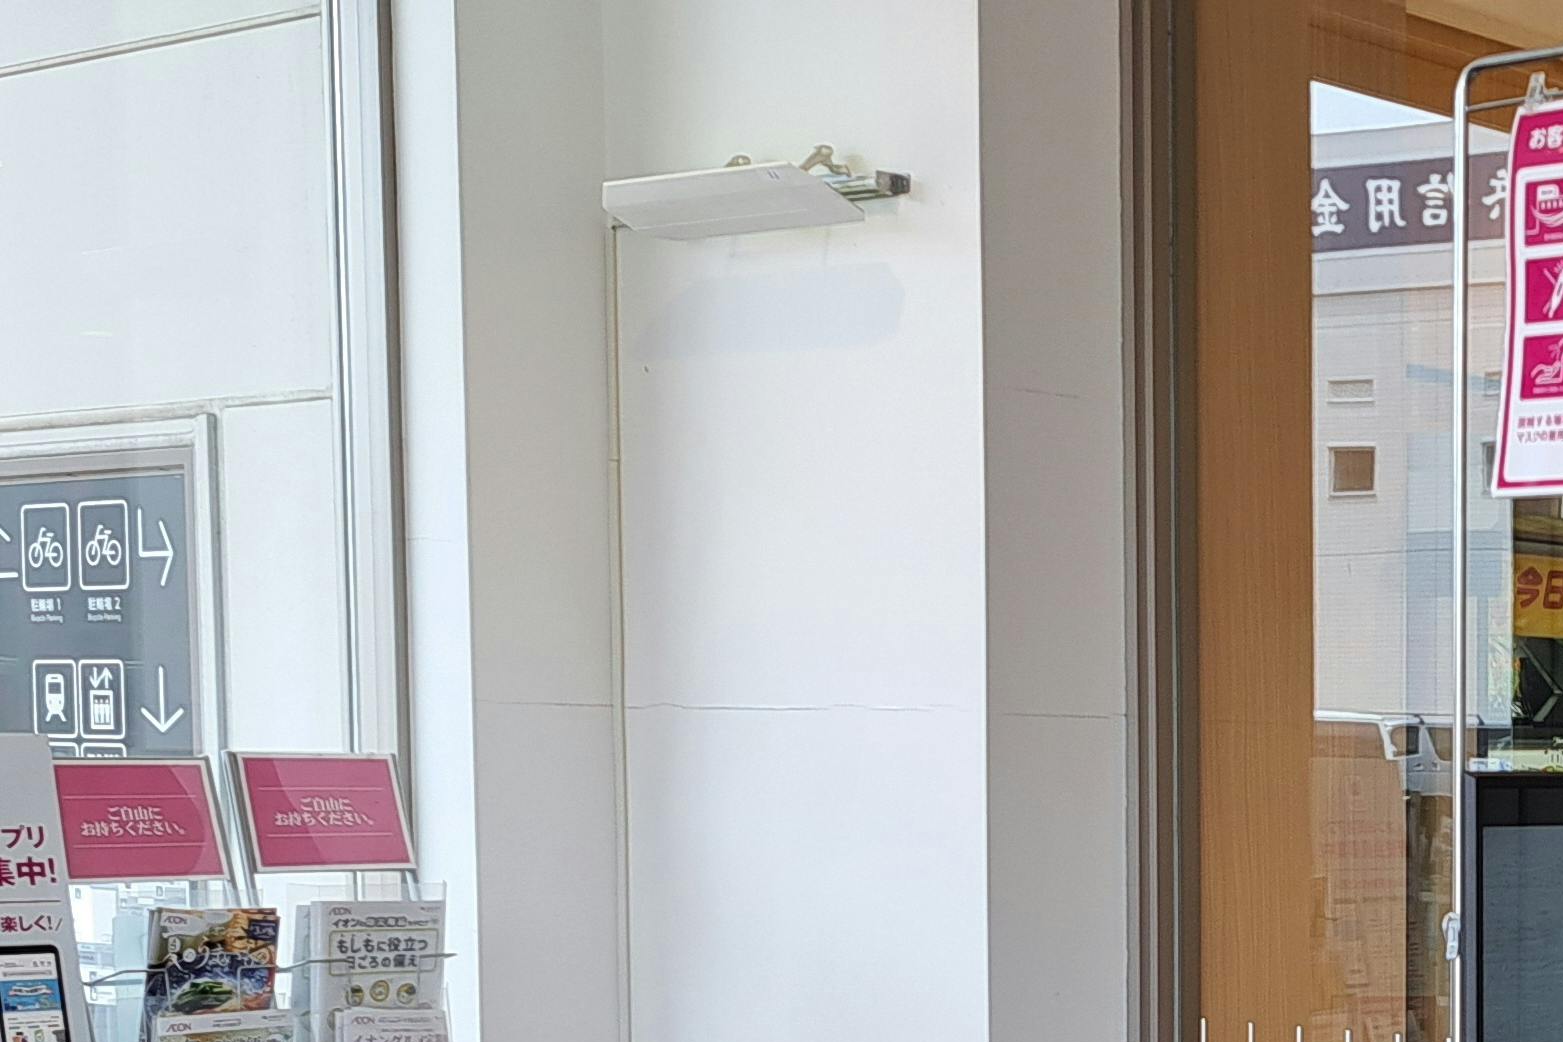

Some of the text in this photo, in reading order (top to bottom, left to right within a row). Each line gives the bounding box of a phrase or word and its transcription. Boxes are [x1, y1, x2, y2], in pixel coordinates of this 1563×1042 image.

[274, 812, 374, 826] お持ちください。
[80, 821, 186, 837] お持ちください。
